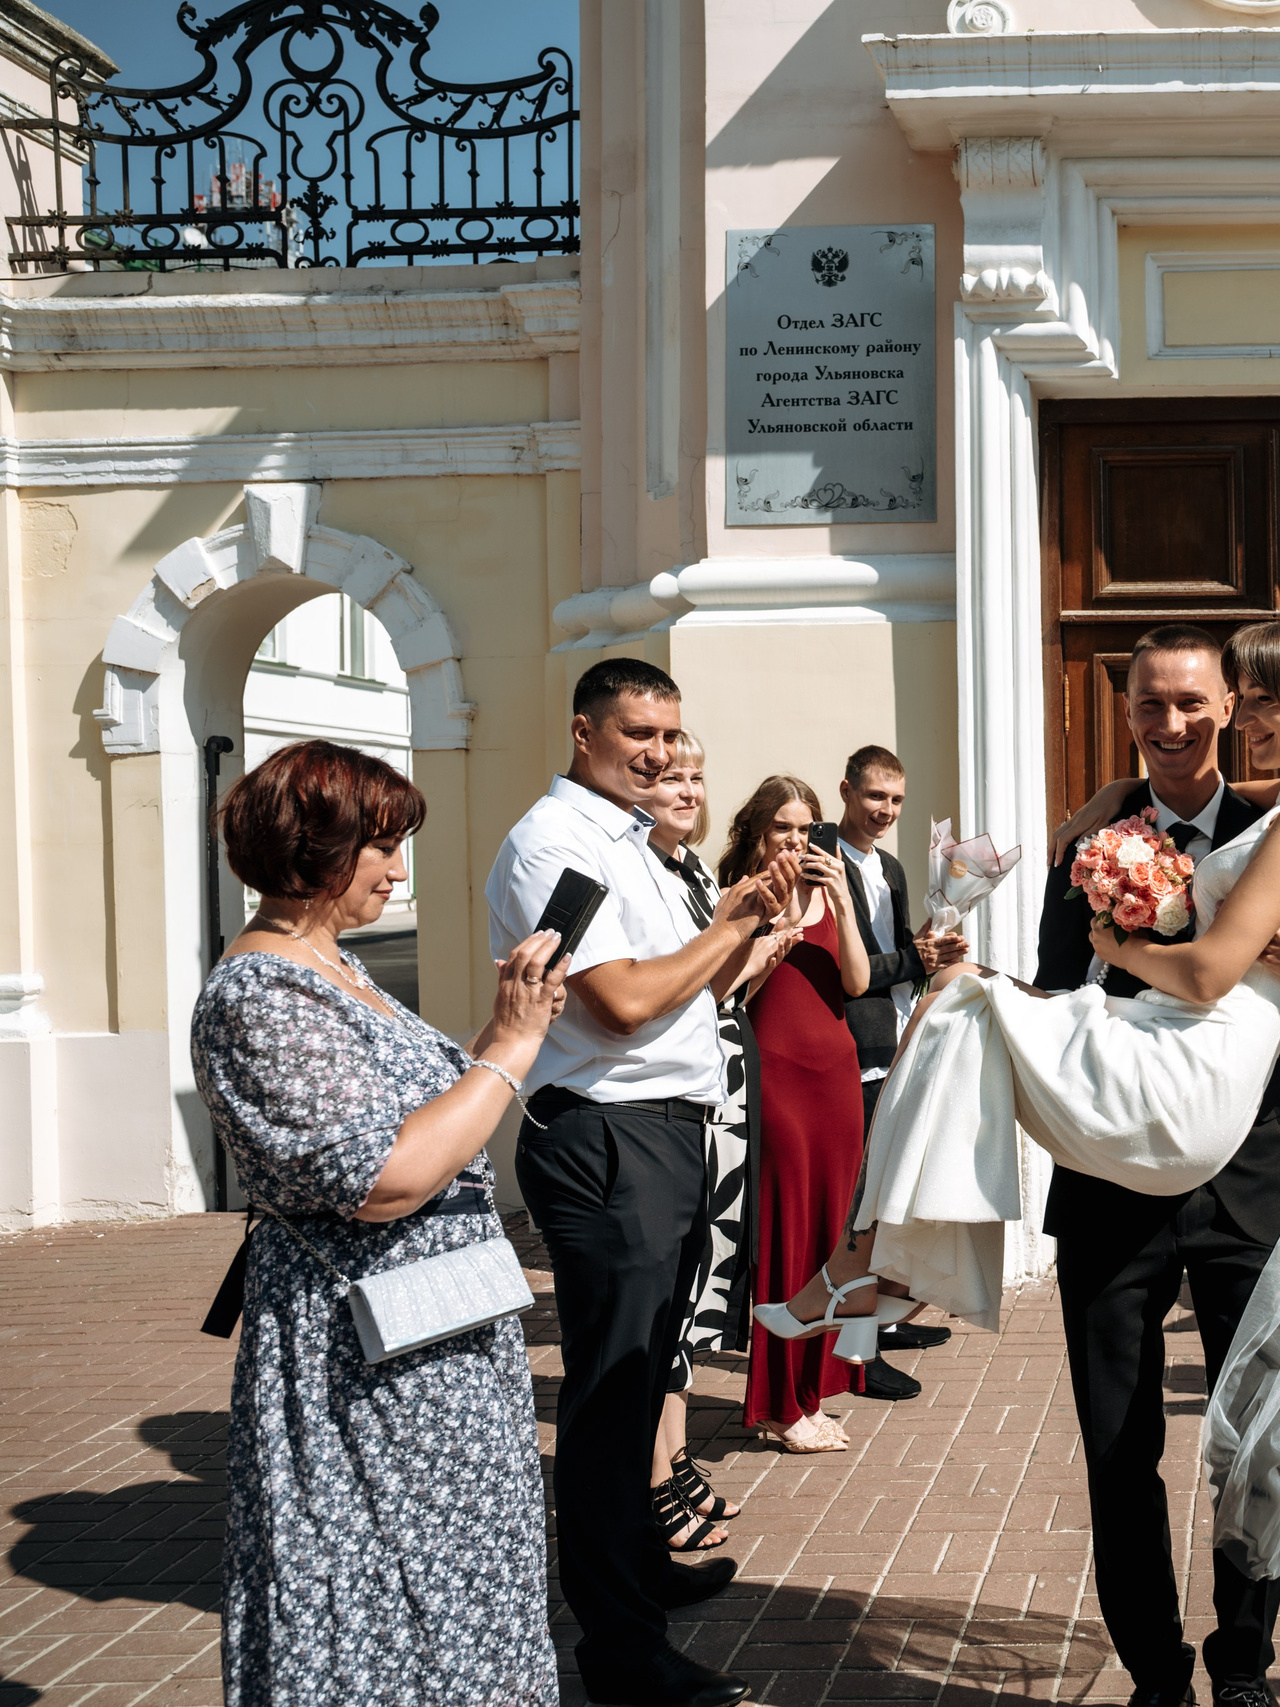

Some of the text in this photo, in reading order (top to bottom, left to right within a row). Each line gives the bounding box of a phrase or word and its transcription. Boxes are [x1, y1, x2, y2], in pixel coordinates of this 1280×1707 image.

[776, 312, 883, 330] Отдел ЗАГС
[739, 339, 922, 357] по Ленинскому району
[756, 365, 904, 385] города Ульяновска
[761, 390, 899, 408] Агентства ЗАГС
[748, 418, 914, 434] Ульяновской области
